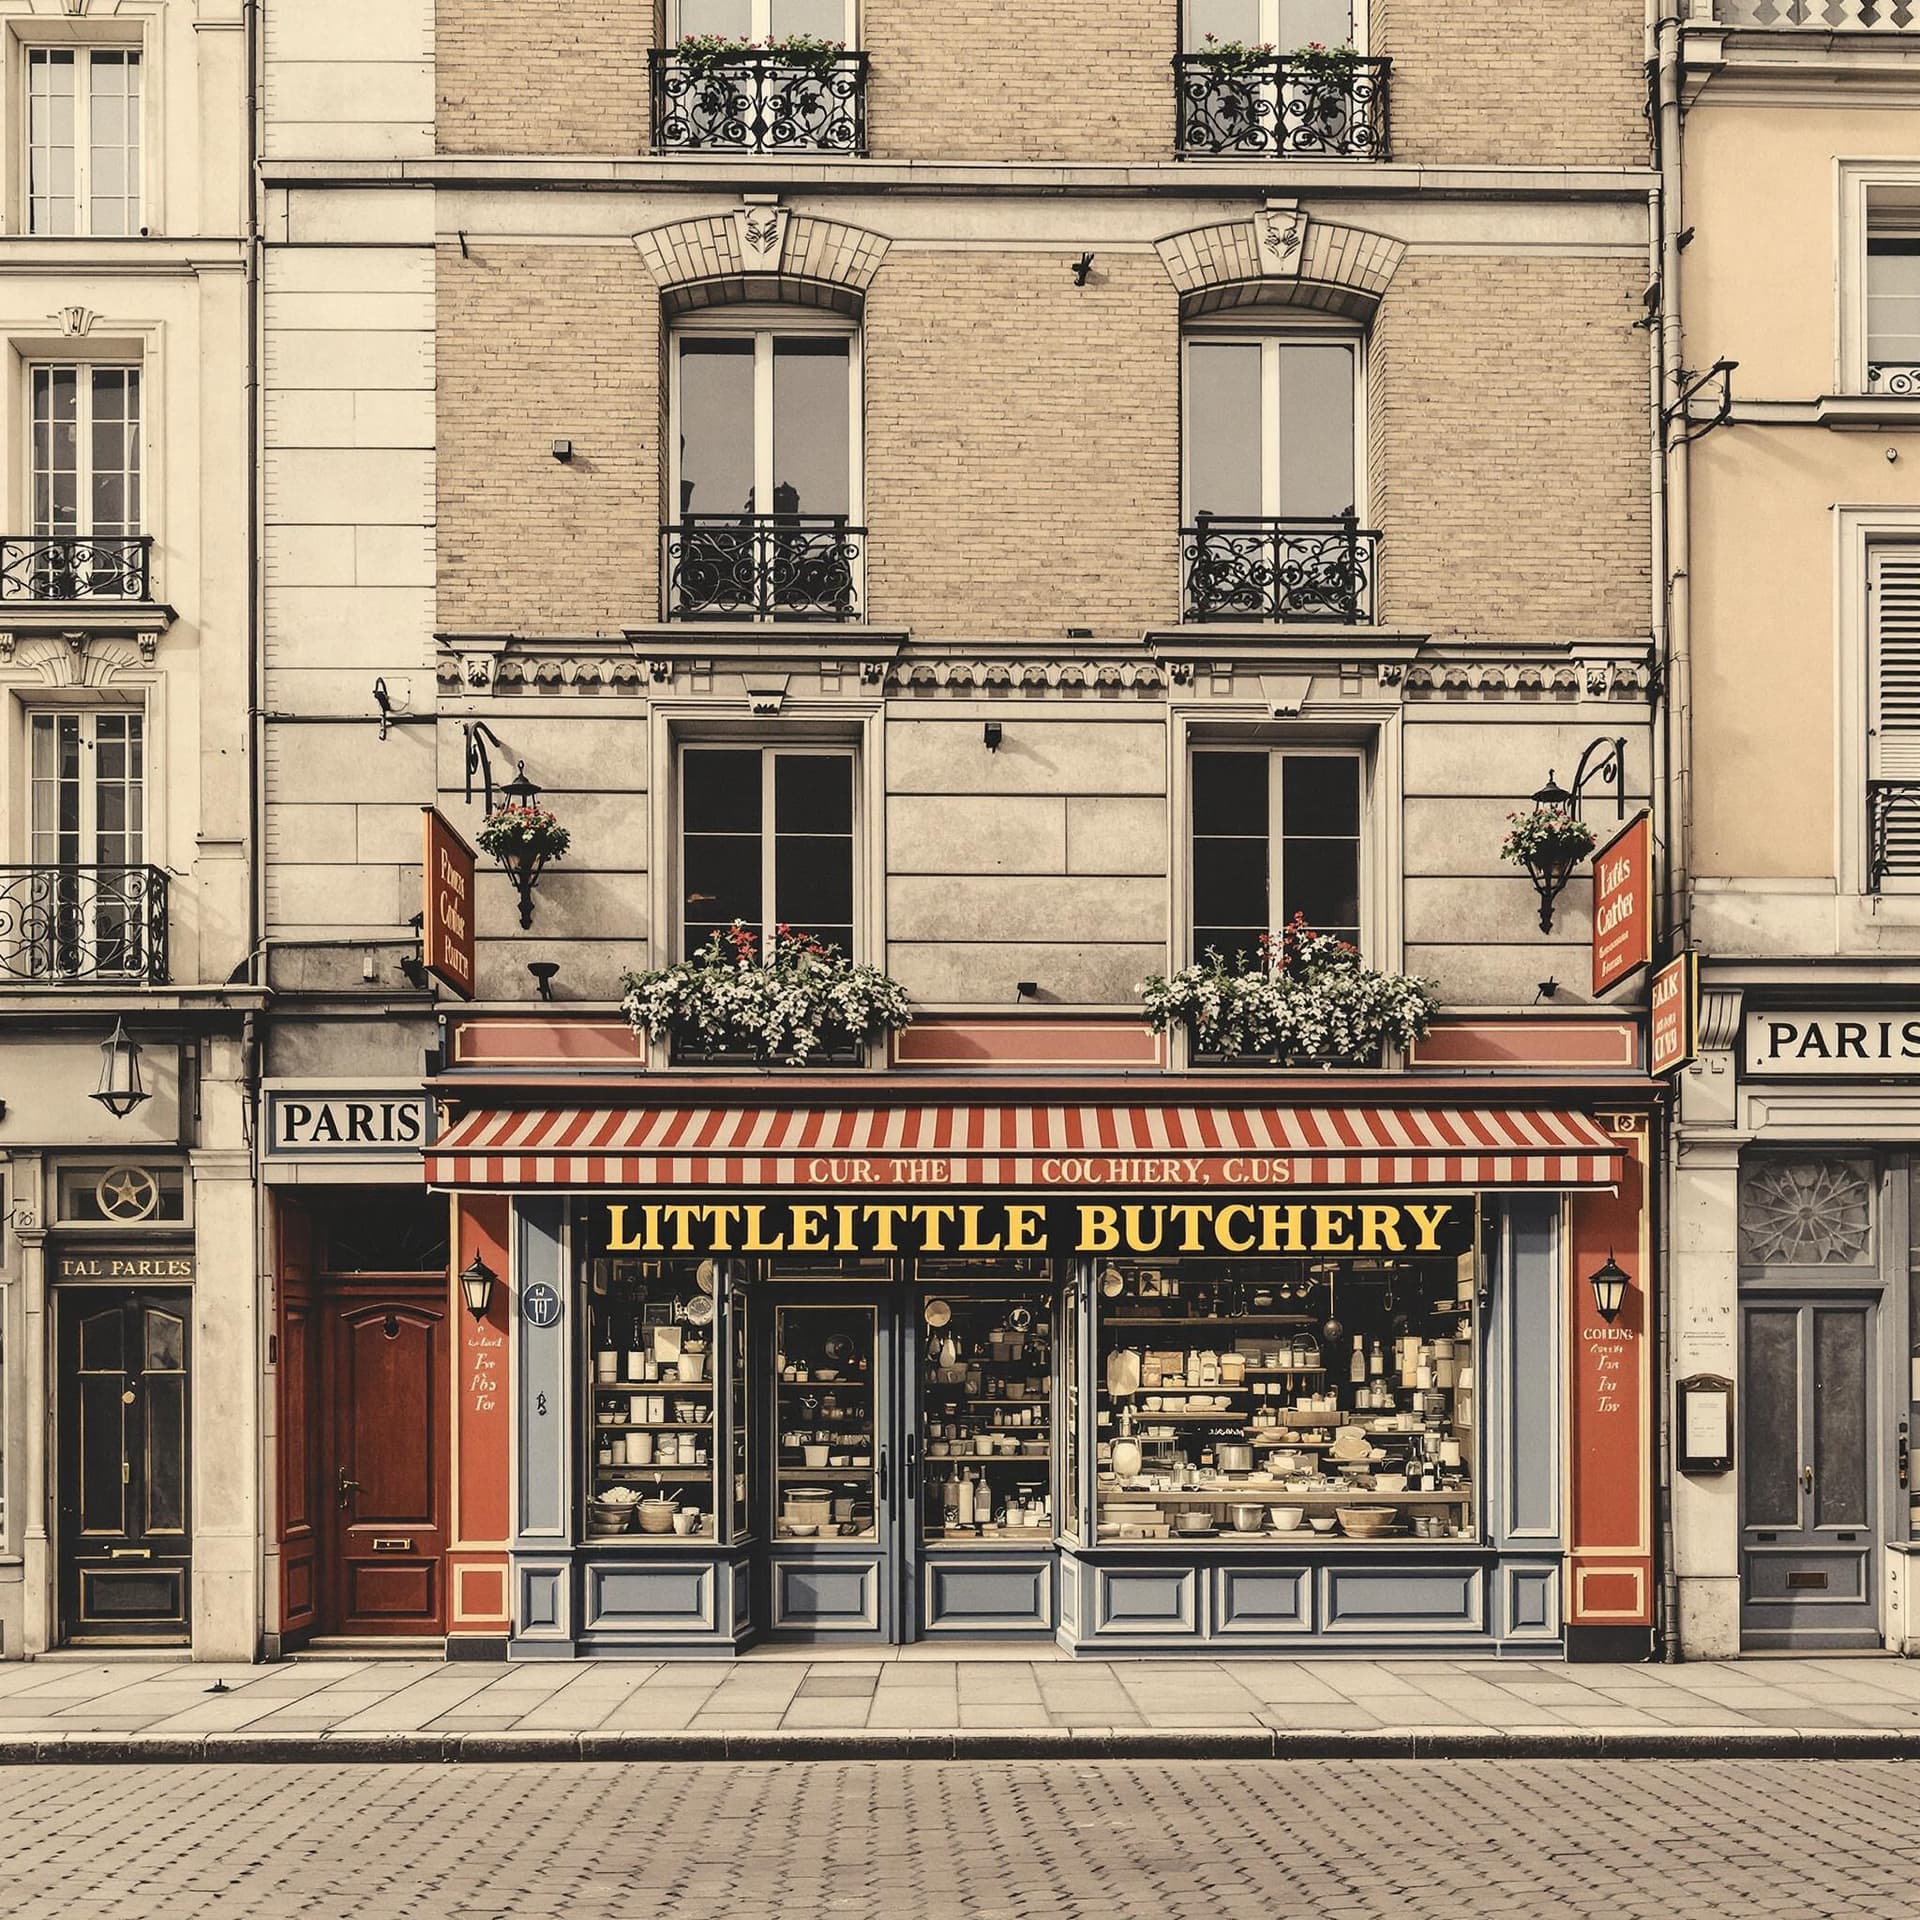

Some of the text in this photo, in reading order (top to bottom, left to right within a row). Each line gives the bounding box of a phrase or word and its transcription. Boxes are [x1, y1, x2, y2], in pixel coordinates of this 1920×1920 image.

[1767, 1022, 1920, 1058] PARIS
[283, 1103, 420, 1142] PARIS
[808, 1158, 880, 1183] CUR.
[888, 1159, 949, 1183] THE
[605, 1204, 1453, 1252] LITTLEITTLE BUTCHERY
[62, 1260, 102, 1275] TAL
